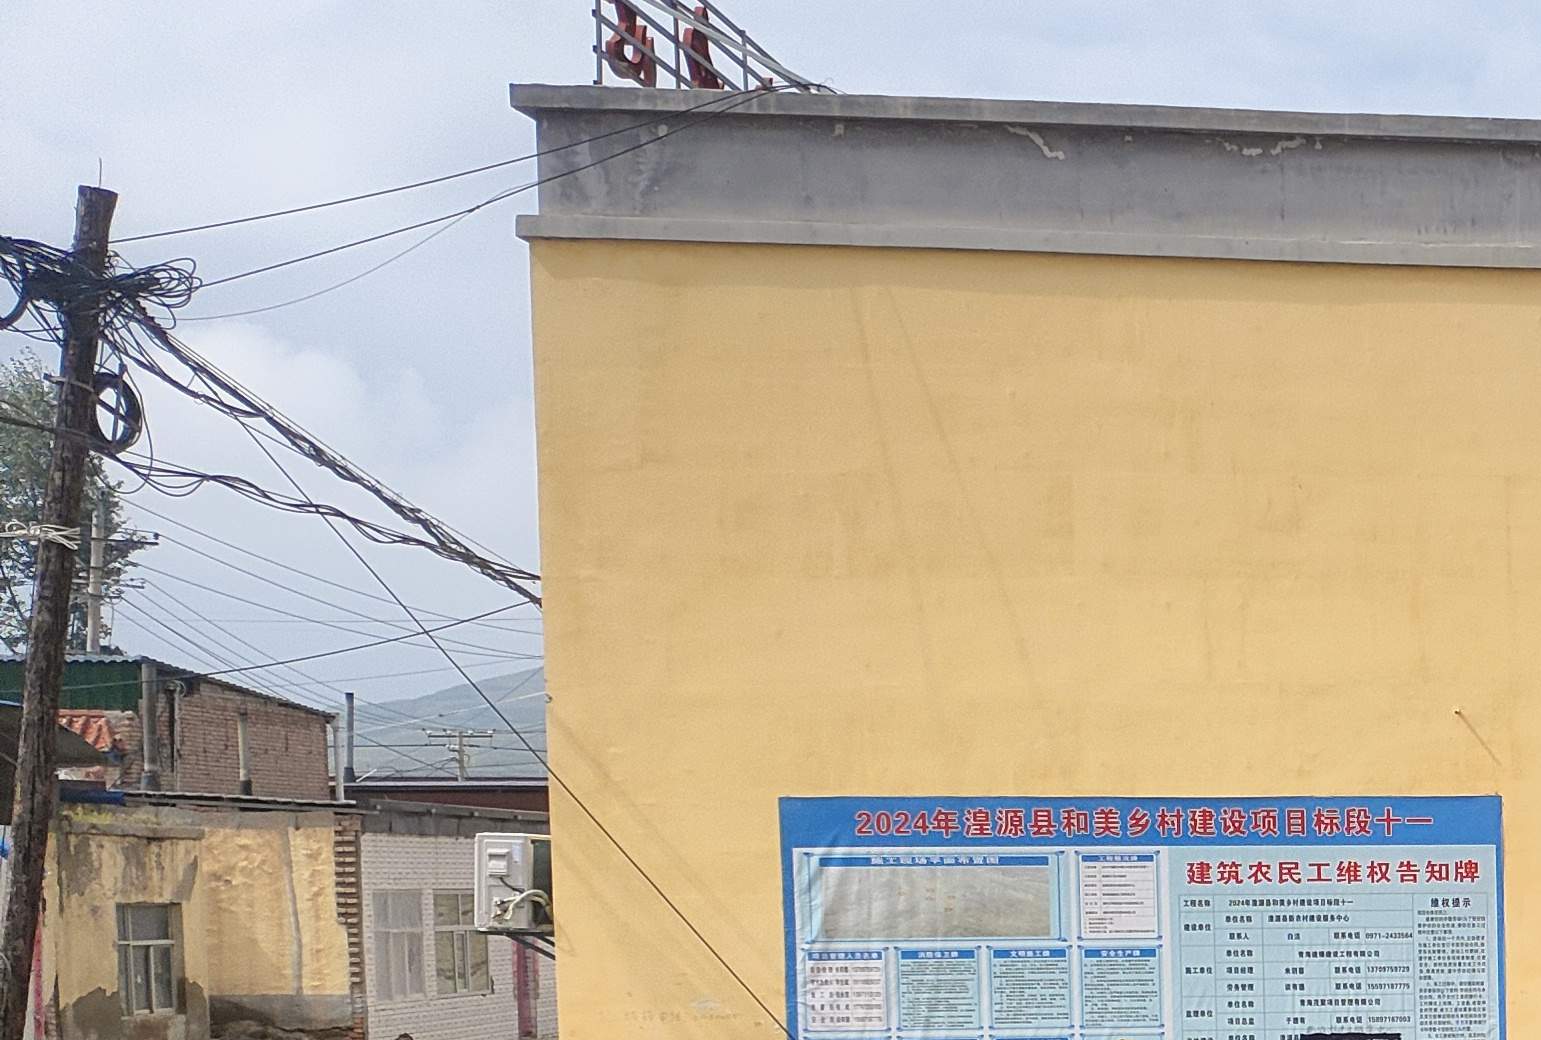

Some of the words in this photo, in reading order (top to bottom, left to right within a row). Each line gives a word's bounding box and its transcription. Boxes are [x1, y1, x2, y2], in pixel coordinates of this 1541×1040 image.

[855, 807, 1433, 838] 2024年湟源县和美乡村建设项目标段十一
[1186, 860, 1481, 885] 建筑农民工维权告知牌
